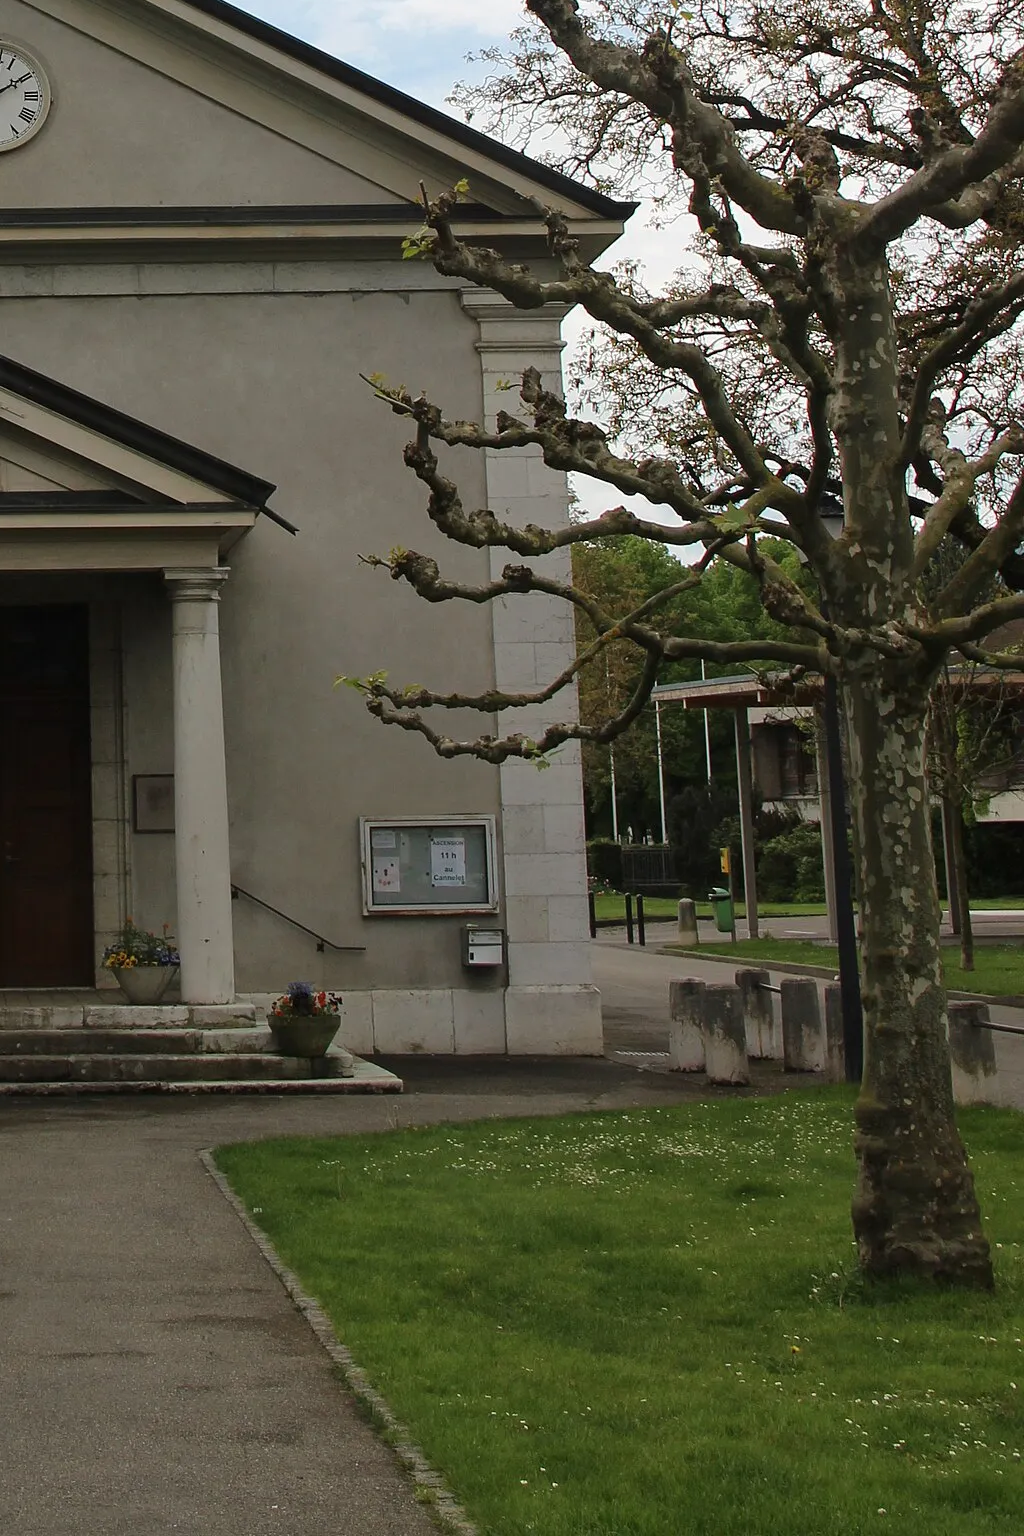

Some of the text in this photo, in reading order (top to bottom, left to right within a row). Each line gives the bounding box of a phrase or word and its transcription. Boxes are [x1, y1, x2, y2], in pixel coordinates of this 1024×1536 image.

[6, 58, 16, 71] I
[24, 91, 39, 101] III
[9, 124, 20, 135] V
